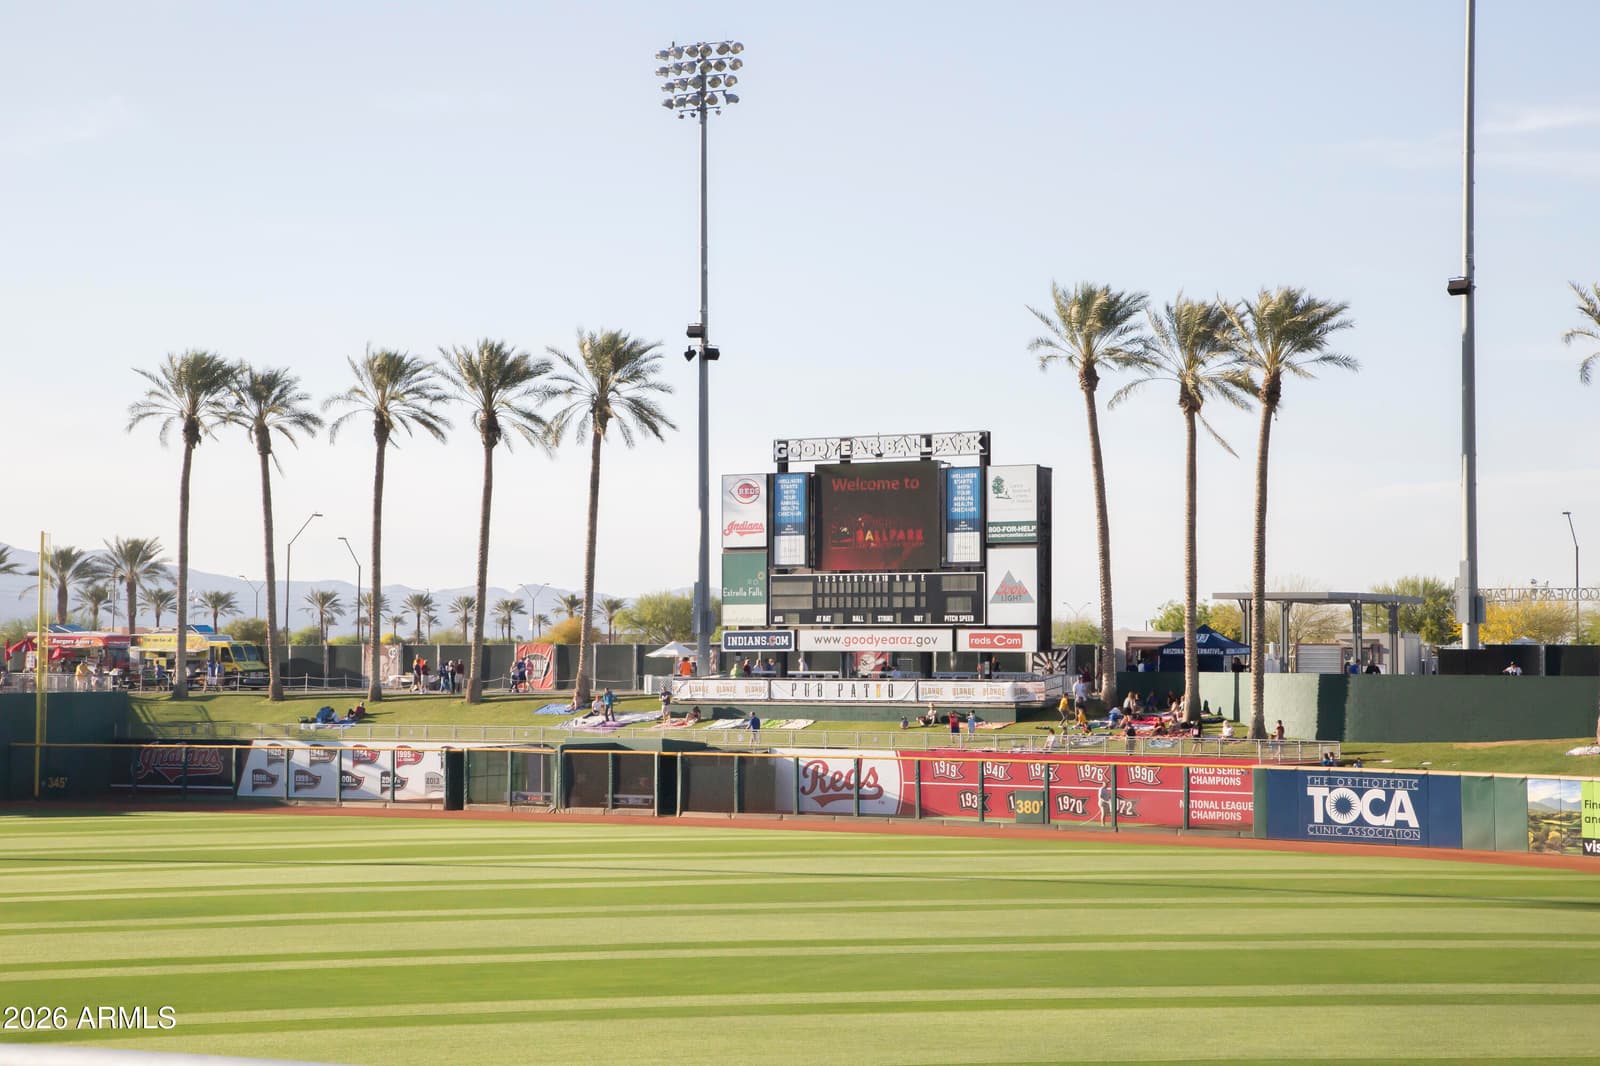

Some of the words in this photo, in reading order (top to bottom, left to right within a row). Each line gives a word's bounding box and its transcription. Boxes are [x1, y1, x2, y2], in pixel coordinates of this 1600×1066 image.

[775, 437, 881, 457] GOODYEAR
[882, 431, 984, 453] BALLPARK
[738, 486, 760, 495] REDS
[831, 476, 900, 491] Welcome
[903, 477, 920, 489] to
[723, 520, 765, 536] Indians
[856, 529, 923, 541] BALLPARK
[723, 586, 747, 597] Estrella
[748, 586, 763, 597] Falls
[1001, 594, 1022, 602] LIGHT
[727, 635, 789, 647] INDIANS.COM
[814, 634, 938, 648] www.goodyearaz.gov
[791, 683, 823, 697] PUB
[837, 683, 894, 698] PATIO
[130, 742, 224, 782] Indians
[934, 760, 956, 777] 1919
[341, 775, 352, 783] 001
[381, 776, 397, 784] 207
[1079, 764, 1103, 782] 1976
[1130, 766, 1153, 783] 1990
[47, 776, 68, 789] 345'
[800, 755, 884, 807] Reds
[1190, 776, 1242, 786] CHAMPIONS
[1307, 776, 1328, 786] THE
[1336, 777, 1418, 790] ORTHOPEDIC
[960, 792, 978, 808] 193
[1016, 799, 1043, 814] 380'
[1057, 795, 1083, 814] 1970
[1180, 800, 1219, 810] NTIONAL
[1221, 801, 1254, 811] LEAGUE
[1584, 800, 1600, 809] Fin
[1306, 787, 1420, 828] TOCA
[1191, 810, 1242, 821] CHAMPIONS
[1307, 824, 1342, 836] CLINIC
[1347, 826, 1420, 839] ASSOCIATION
